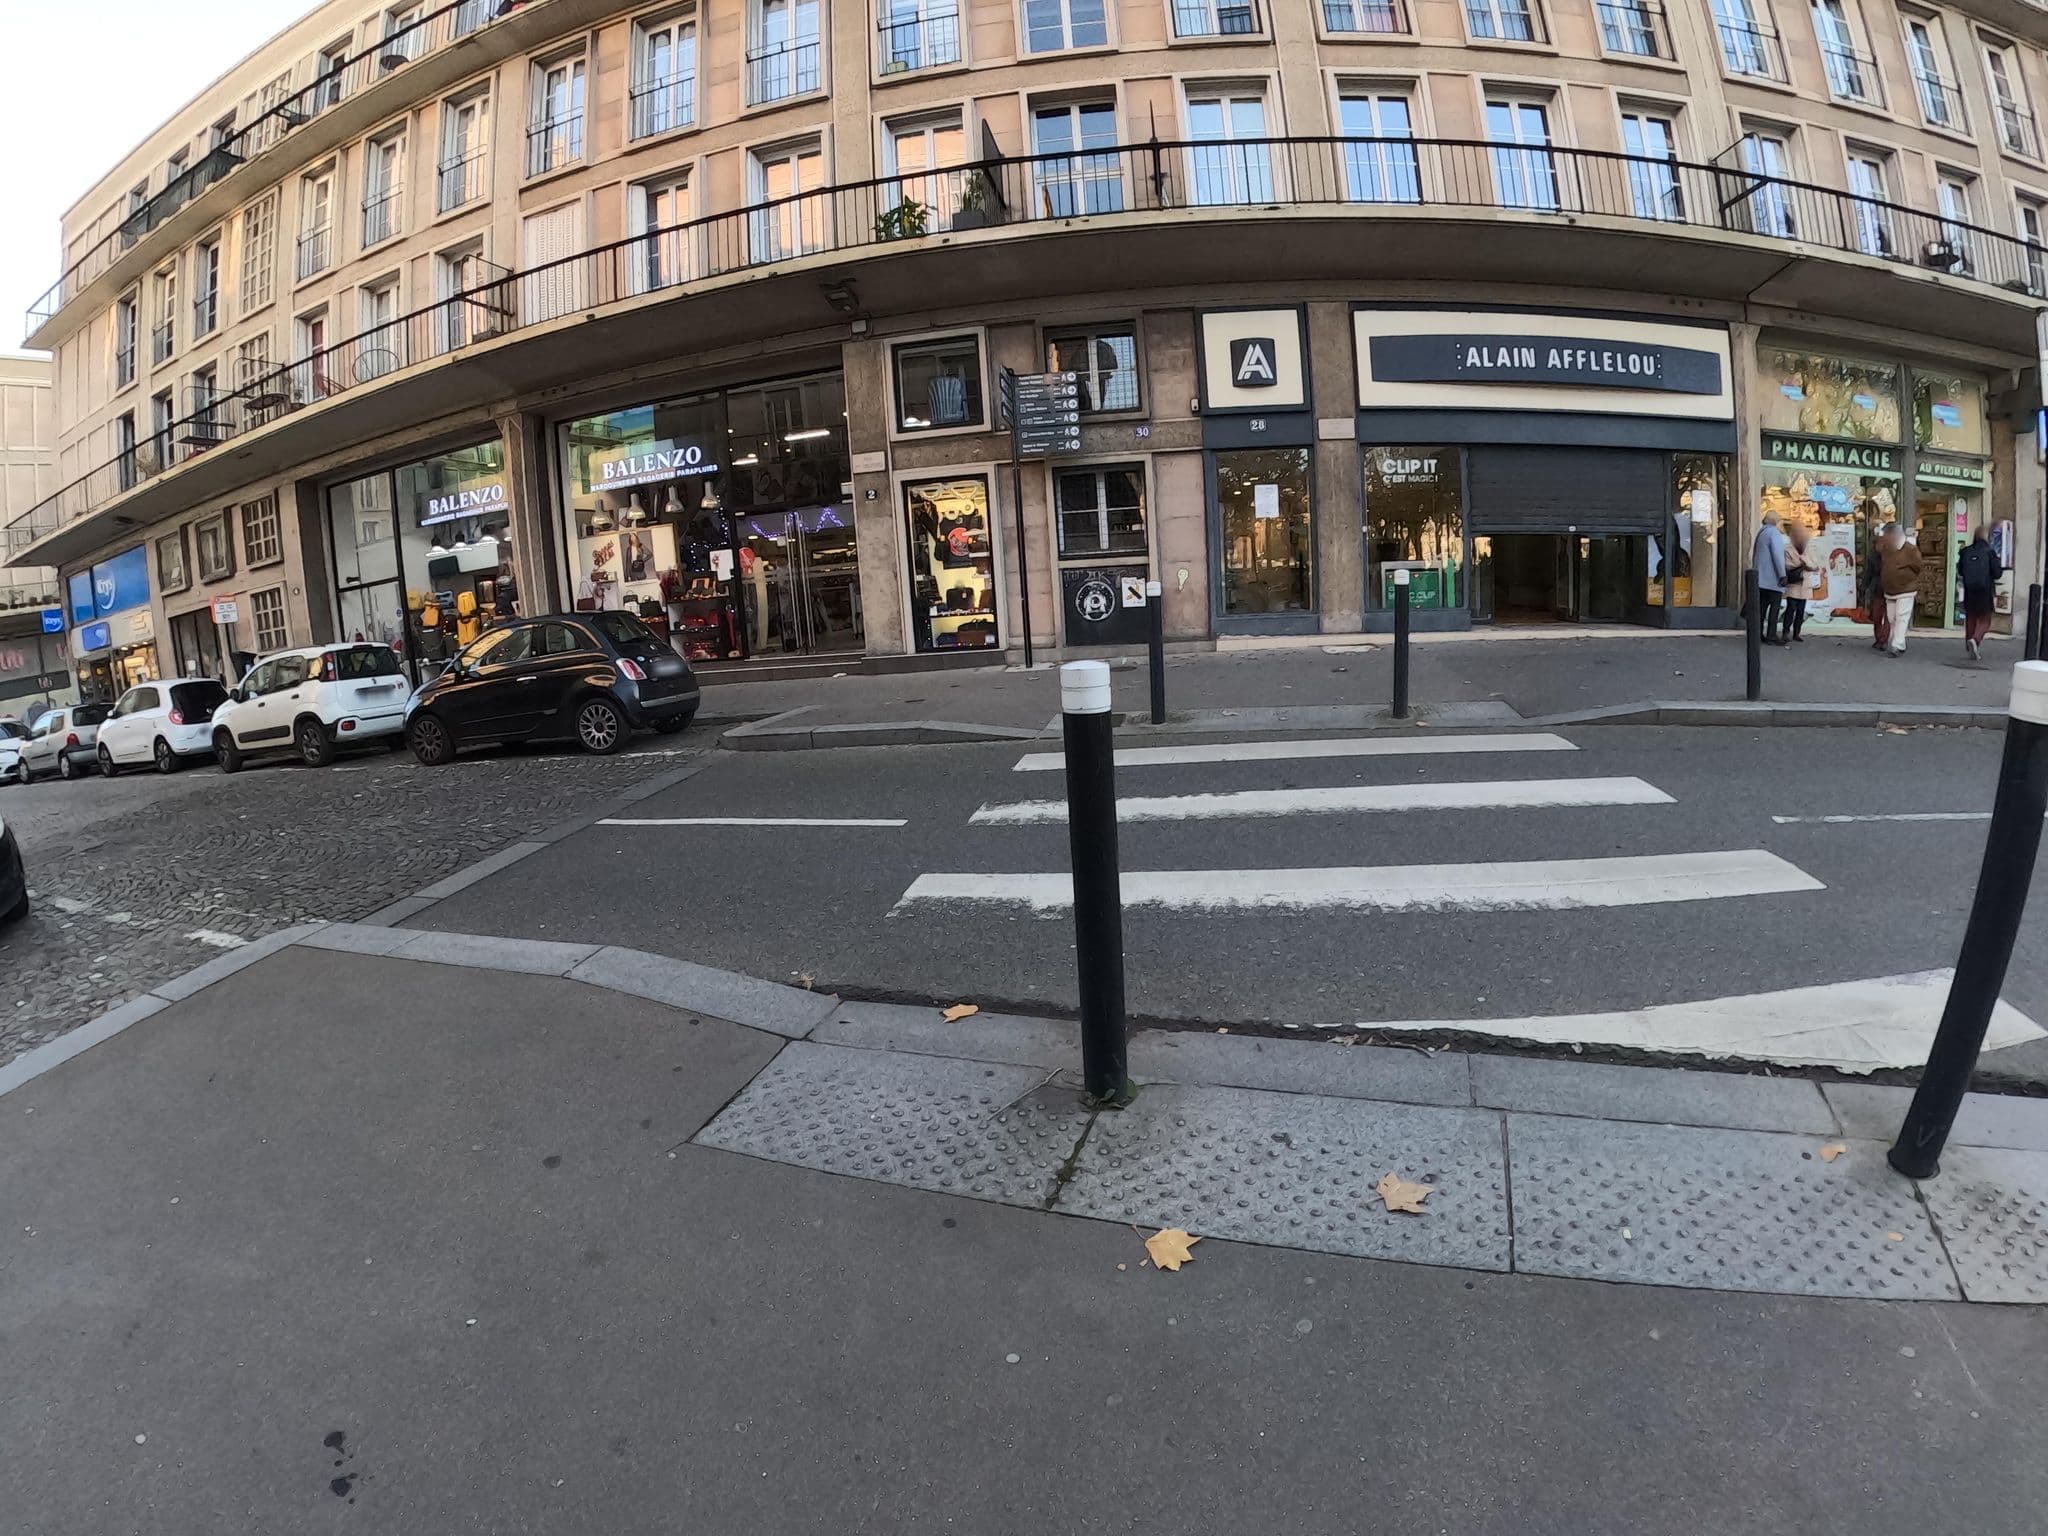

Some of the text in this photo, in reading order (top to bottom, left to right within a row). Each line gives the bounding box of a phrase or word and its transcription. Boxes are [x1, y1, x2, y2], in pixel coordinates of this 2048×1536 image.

[1466, 346, 1655, 376] ALAIN AFFLELOU
[1135, 427, 1149, 437] 30
[602, 446, 702, 480] BALENZO
[1772, 440, 1891, 469] PHARMACIE
[1383, 458, 1438, 474] CLIP IT
[1919, 463, 1932, 474] AU
[429, 484, 503, 515] BALENZO
[867, 489, 876, 499] 2
